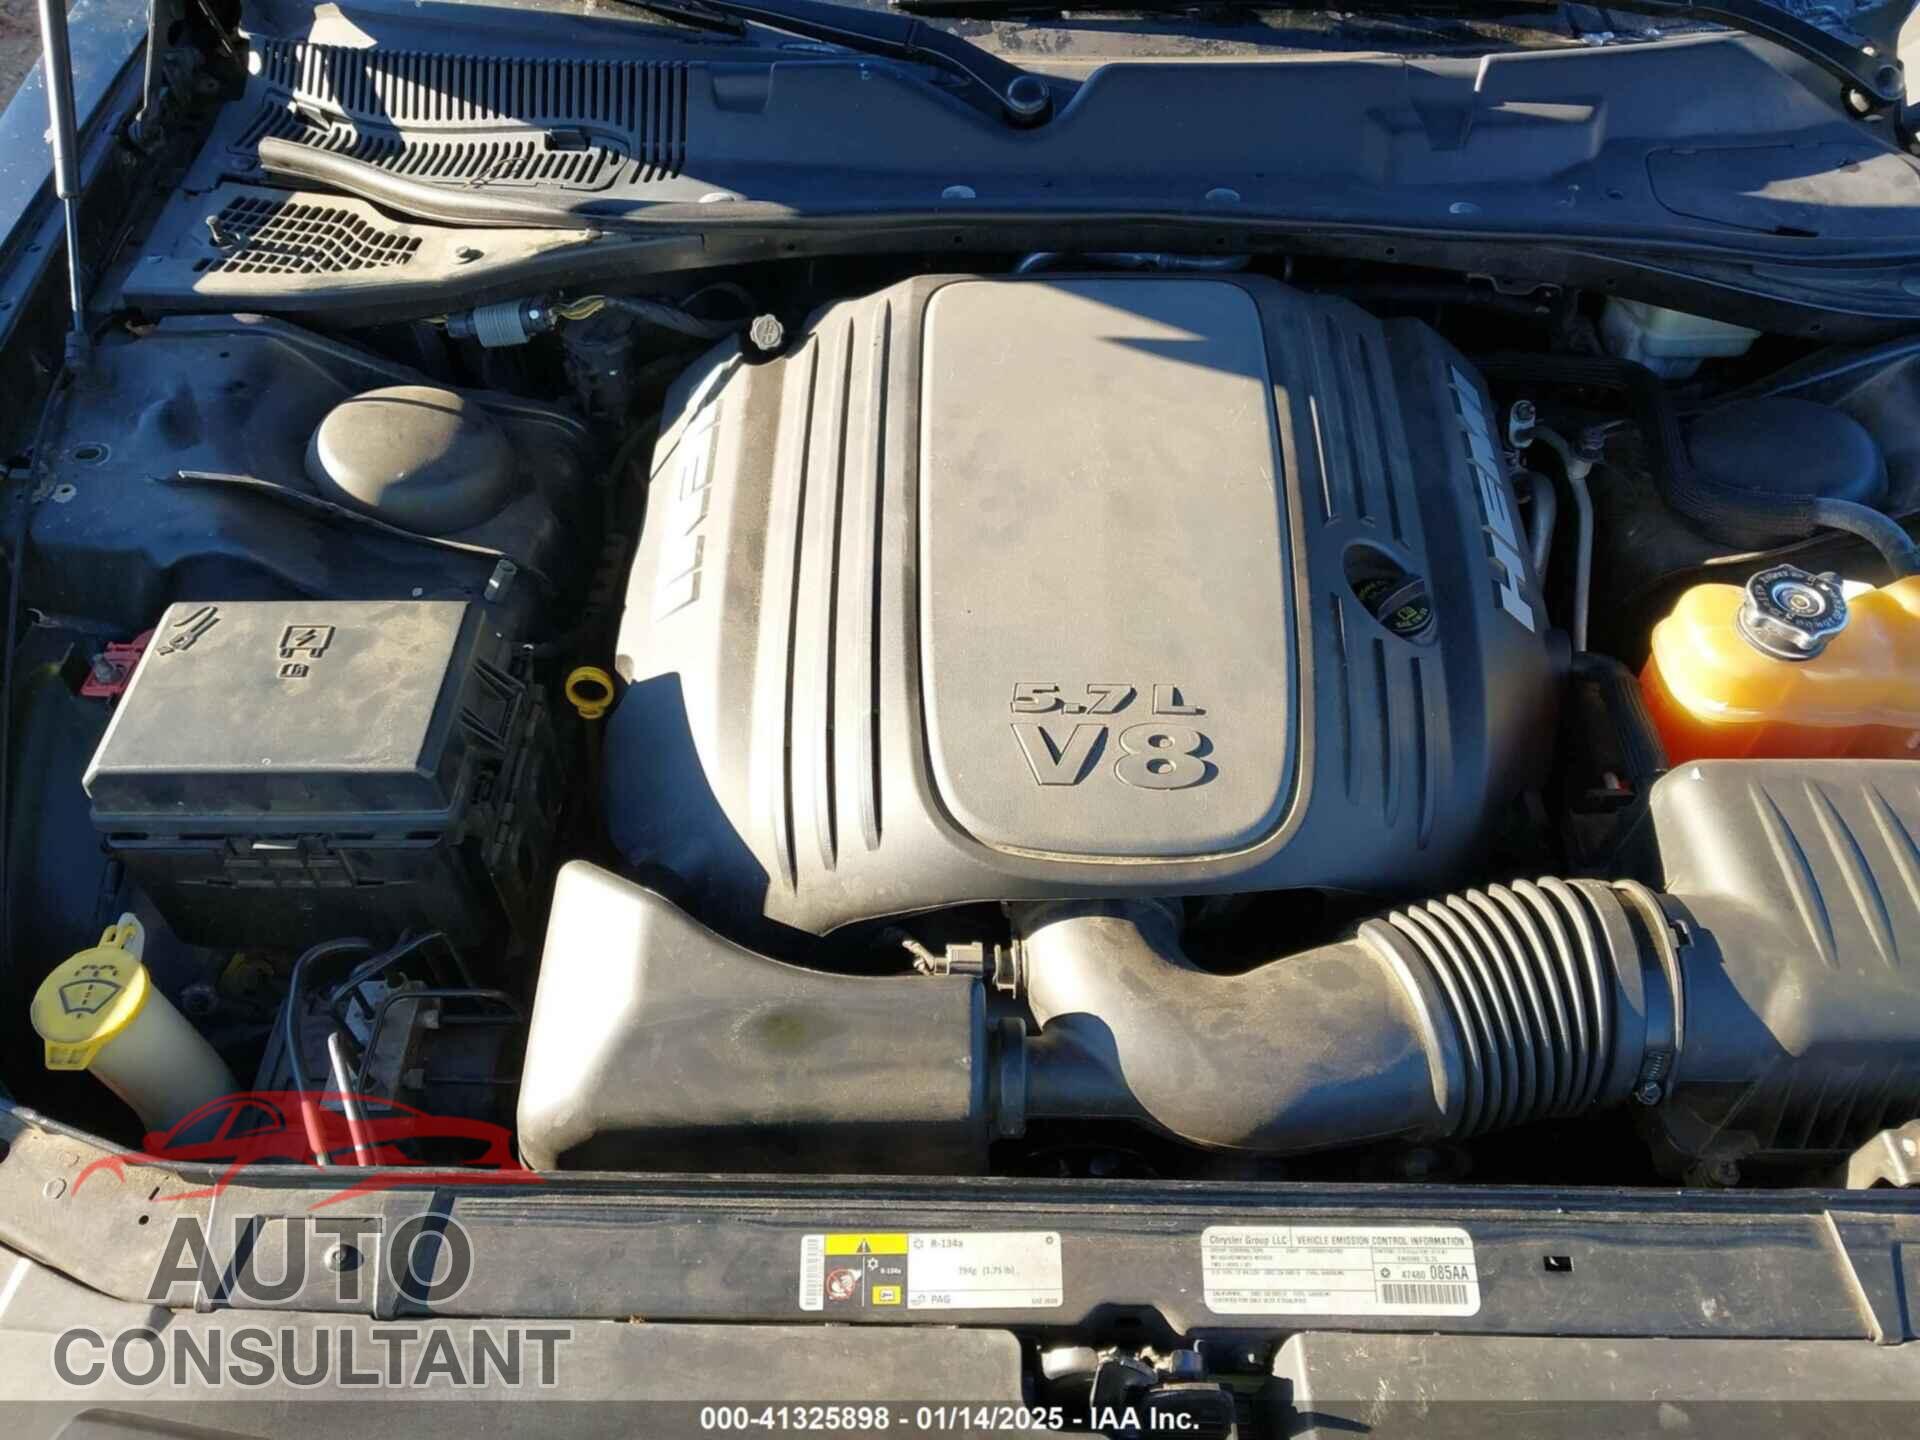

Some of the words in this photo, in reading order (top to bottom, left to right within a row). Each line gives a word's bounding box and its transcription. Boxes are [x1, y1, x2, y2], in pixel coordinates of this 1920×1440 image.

[1010, 721, 1220, 790] V8
[1209, 1234, 1243, 1247] Chrysler
[1245, 1235, 1270, 1247] Group
[1272, 1235, 1289, 1246] LLC
[1297, 1235, 1329, 1246] VEHICLE
[1331, 1235, 1369, 1246] EMISSION
[1371, 1235, 1408, 1246] CONTROL
[1410, 1235, 1466, 1247] INFORMATION
[1429, 1264, 1470, 1281] 085AA
[930, 1294, 951, 1304] PAG
